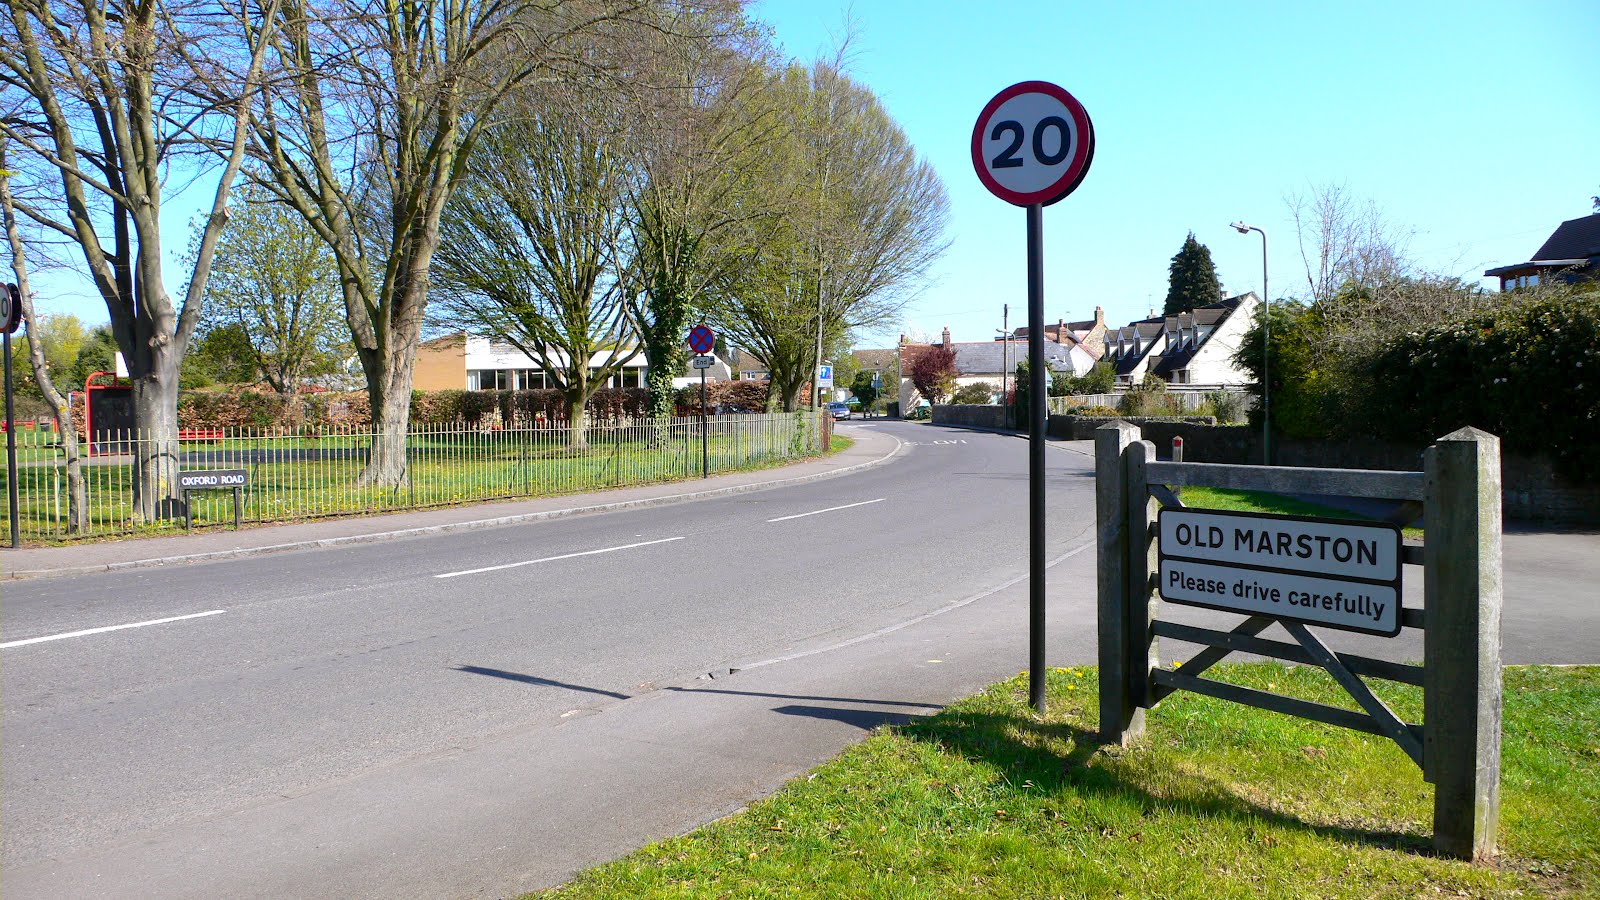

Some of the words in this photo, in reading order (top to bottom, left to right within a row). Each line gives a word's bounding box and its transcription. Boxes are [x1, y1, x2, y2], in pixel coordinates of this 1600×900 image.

[991, 116, 1071, 169] 20
[1, 298, 8, 317] 0
[181, 476, 217, 485] OXFORD
[221, 475, 244, 484] ROAD
[1175, 523, 1224, 549] OLD
[1234, 528, 1377, 566] MARSTON
[1169, 570, 1226, 595] Please
[1232, 579, 1281, 603] drive
[1287, 590, 1385, 621] carefully
